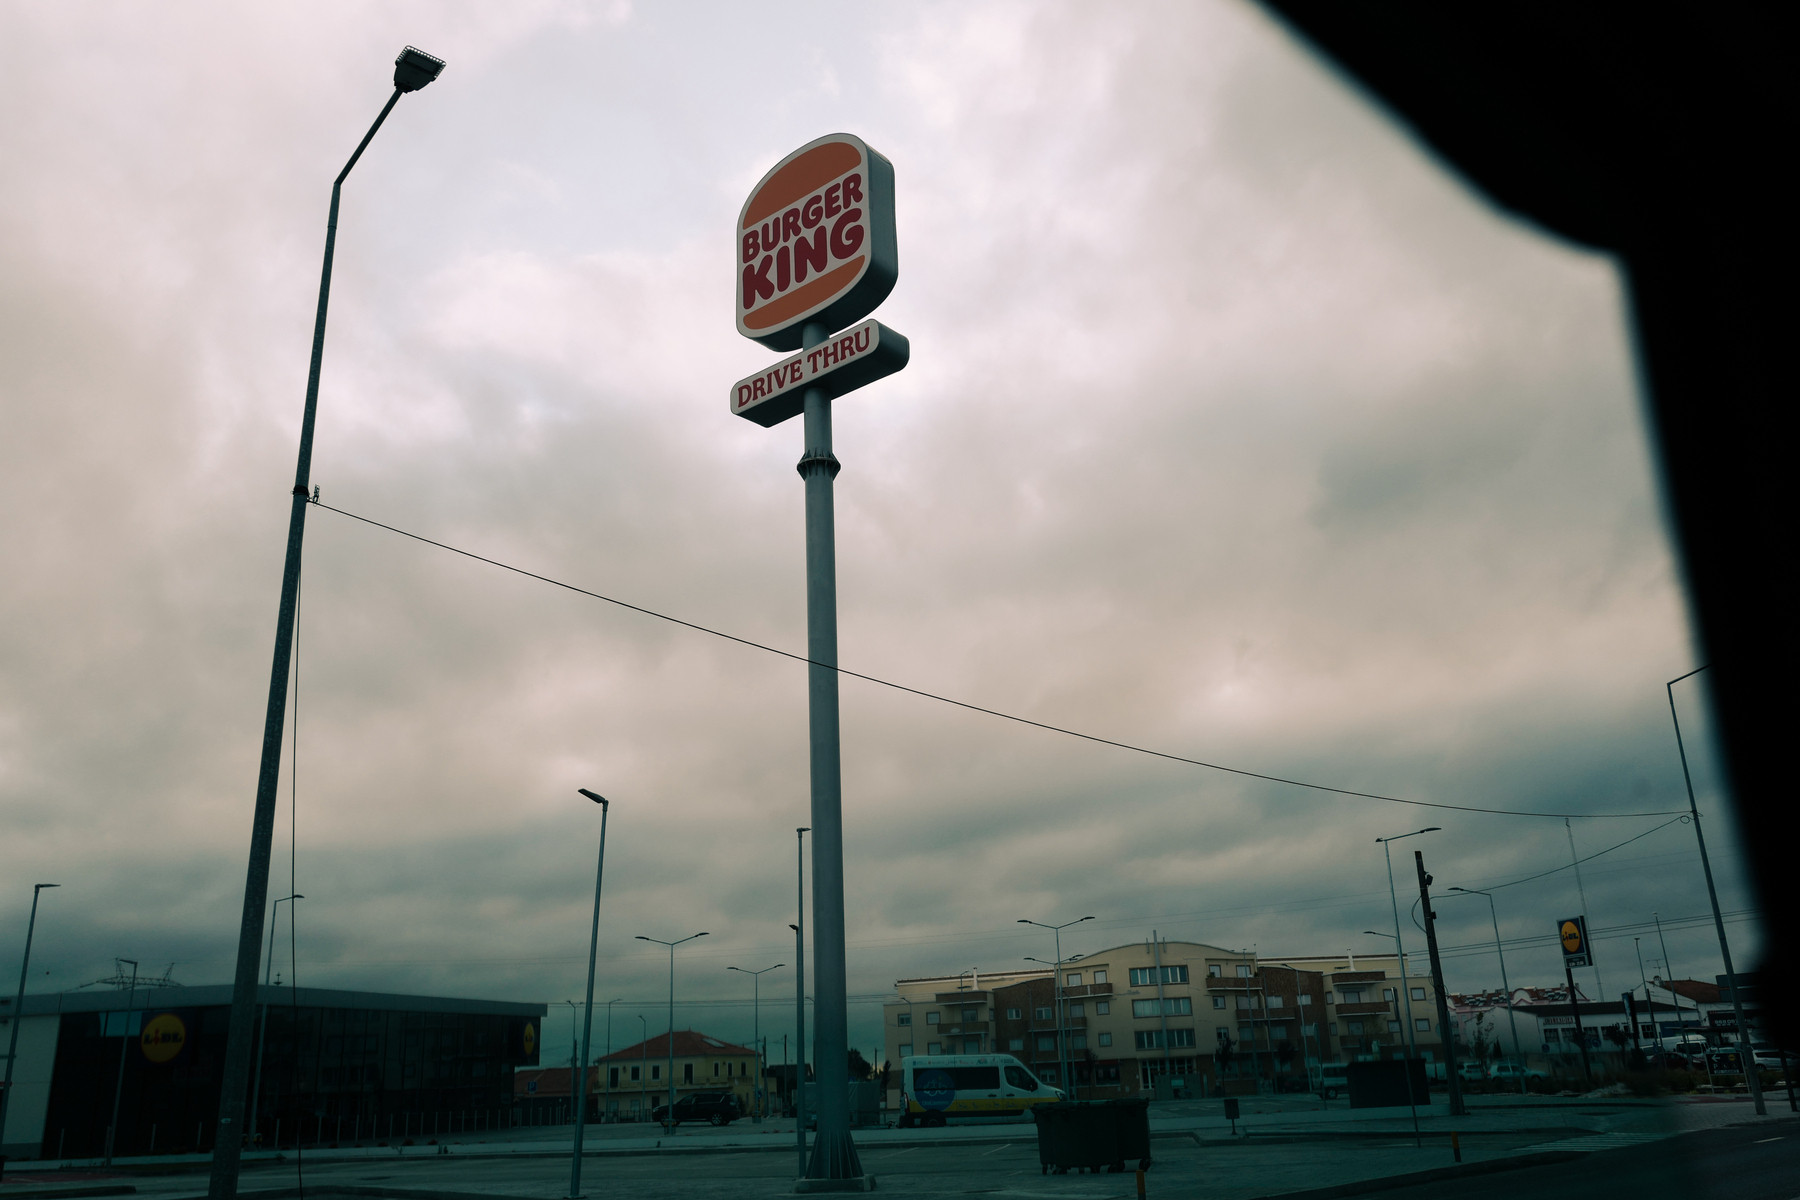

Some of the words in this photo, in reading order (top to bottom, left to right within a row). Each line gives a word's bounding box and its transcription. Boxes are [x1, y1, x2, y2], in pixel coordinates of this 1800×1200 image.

[743, 173, 863, 263] BURGER
[743, 207, 865, 310] KING
[738, 359, 803, 408] DRIVE
[807, 327, 871, 374] THRU
